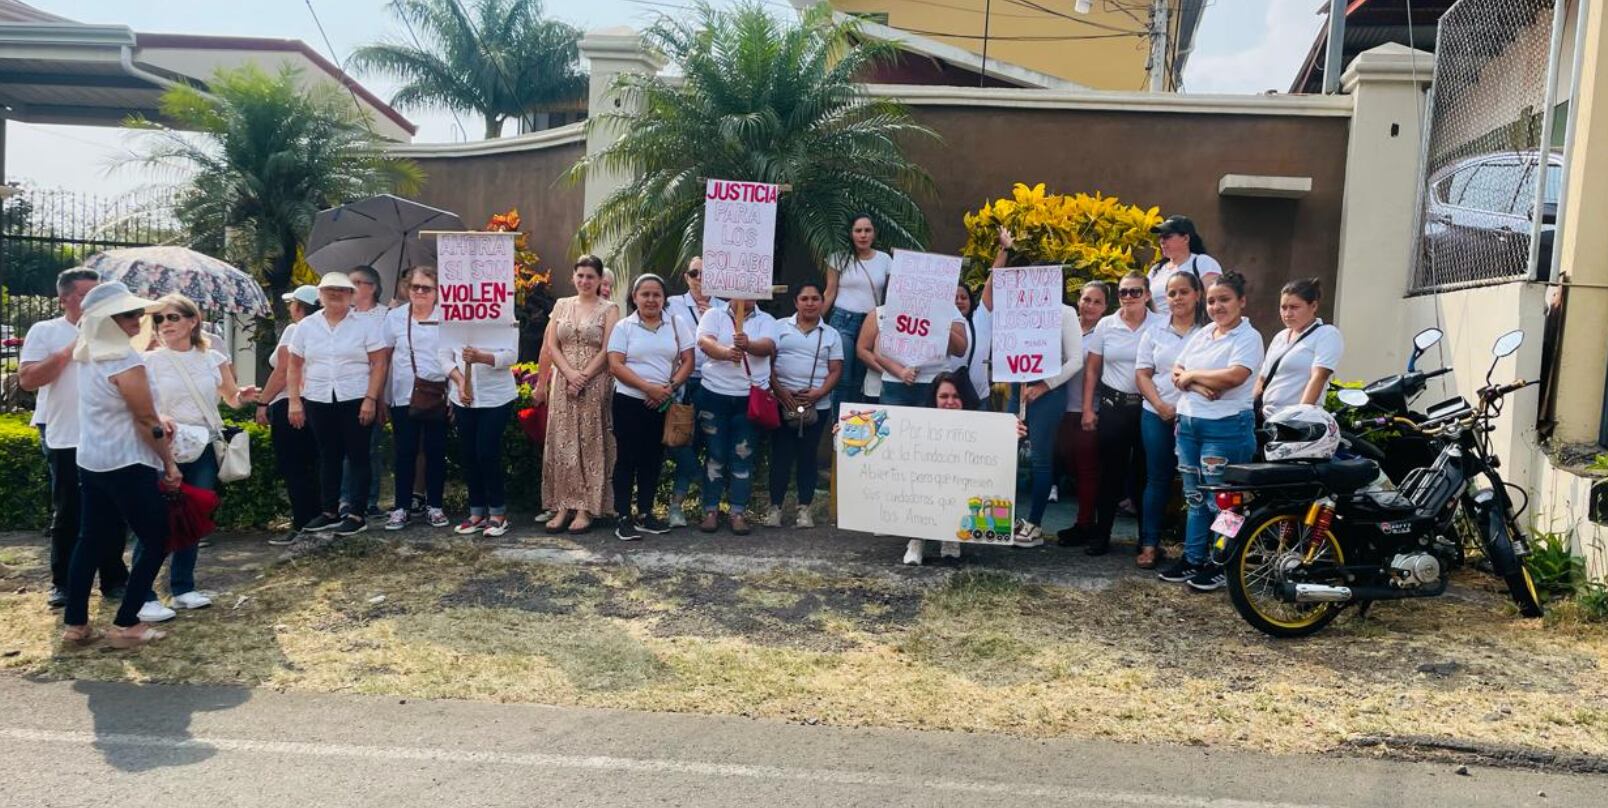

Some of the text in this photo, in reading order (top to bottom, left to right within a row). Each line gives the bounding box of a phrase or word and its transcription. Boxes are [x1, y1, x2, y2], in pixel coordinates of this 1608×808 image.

[707, 182, 777, 203] JUSTICIA
[714, 202, 760, 224] PARA
[721, 224, 758, 248] LOS
[440, 283, 514, 303] VIOLEN-
[441, 303, 501, 321] TADOS
[896, 314, 930, 337] SUS
[995, 332, 1017, 352] NO
[1007, 354, 1043, 374] VOZ
